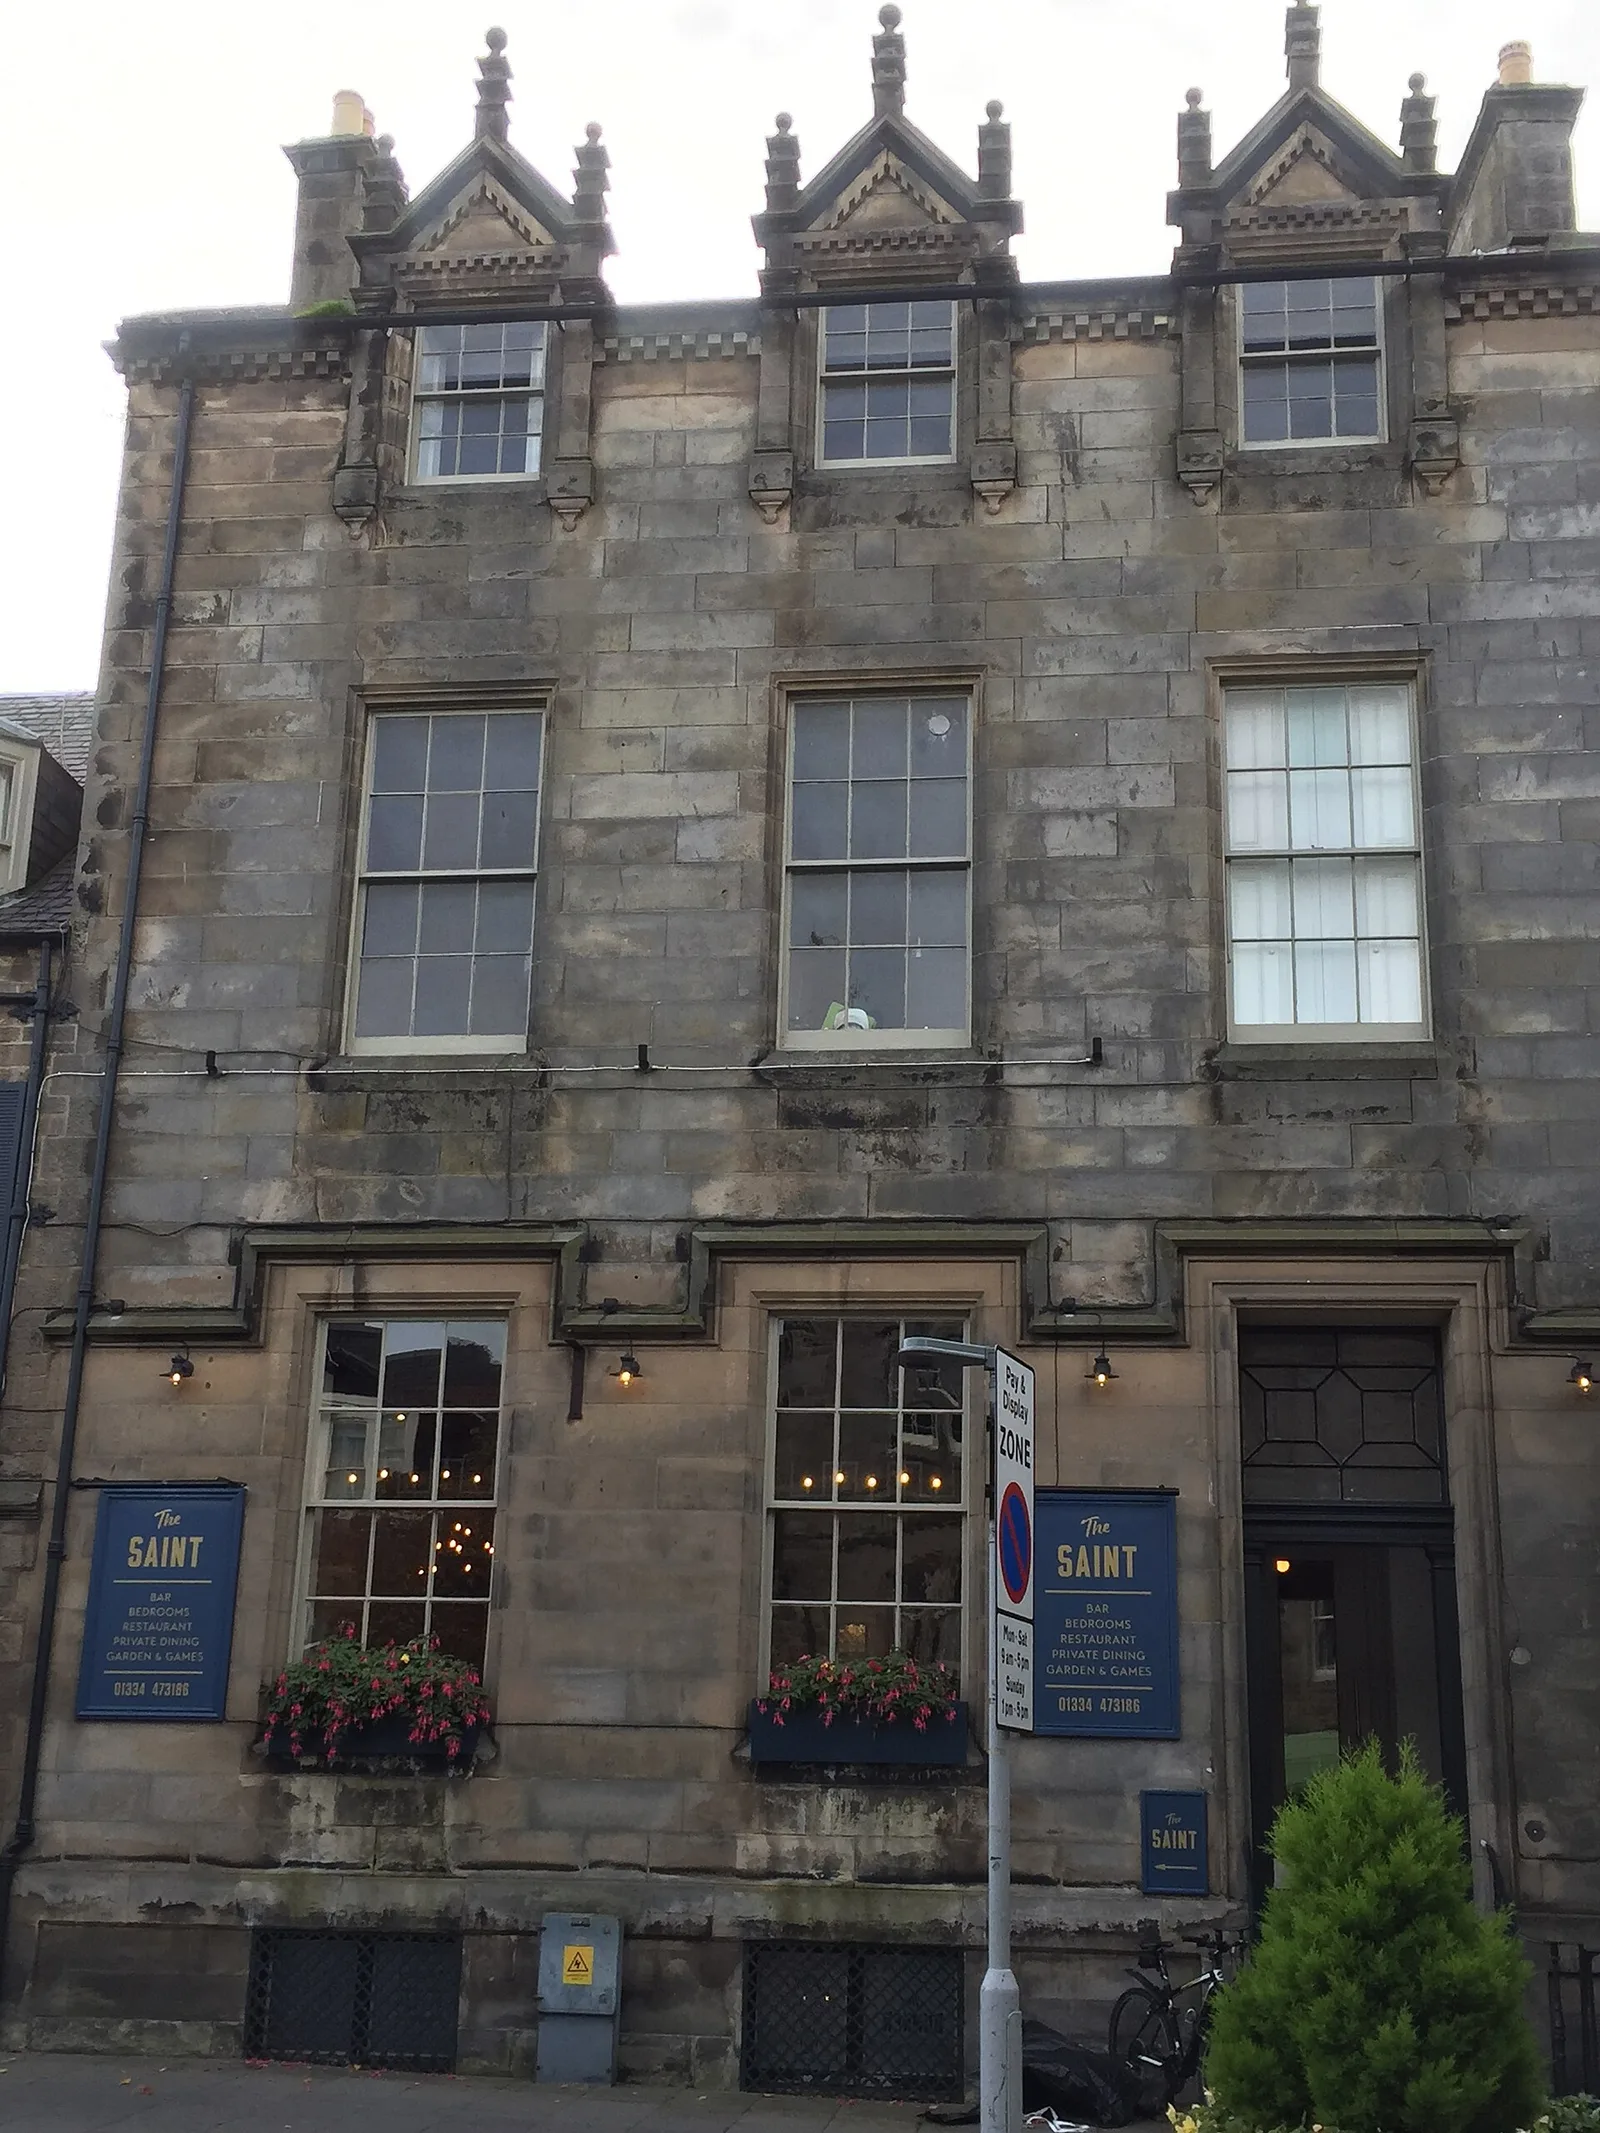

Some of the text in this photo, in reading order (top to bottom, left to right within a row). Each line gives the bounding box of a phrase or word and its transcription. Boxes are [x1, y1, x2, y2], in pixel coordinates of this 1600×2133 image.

[1006, 1365, 1018, 1393] Pay
[1003, 1390, 1028, 1425] Display
[1000, 1425, 1030, 1469] ZONE
[154, 1509, 181, 1529] The
[1081, 1515, 1111, 1537] The
[128, 1536, 203, 1567] SAINT
[1058, 1545, 1137, 1578] SAINT
[150, 1593, 171, 1601] BAR
[129, 1607, 190, 1617] BEDROOMS
[1086, 1604, 1109, 1613] BAR
[122, 1622, 192, 1632] RESTAURANT
[1065, 1618, 1131, 1629] BEDROOMS
[113, 1637, 199, 1647] PRIVATE DINING
[1060, 1634, 1136, 1645] RESTAURANT
[106, 1651, 204, 1662] GARDEN & GAMES
[1052, 1650, 1145, 1661] PRIVATE DINING
[1047, 1665, 1152, 1676] GARDEN & GAMES
[114, 1682, 189, 1697] 01334 473186
[1006, 1675, 1025, 1698] Sunday
[1059, 1697, 1140, 1713] 01334 473186
[1152, 1829, 1197, 1849] SAINT
